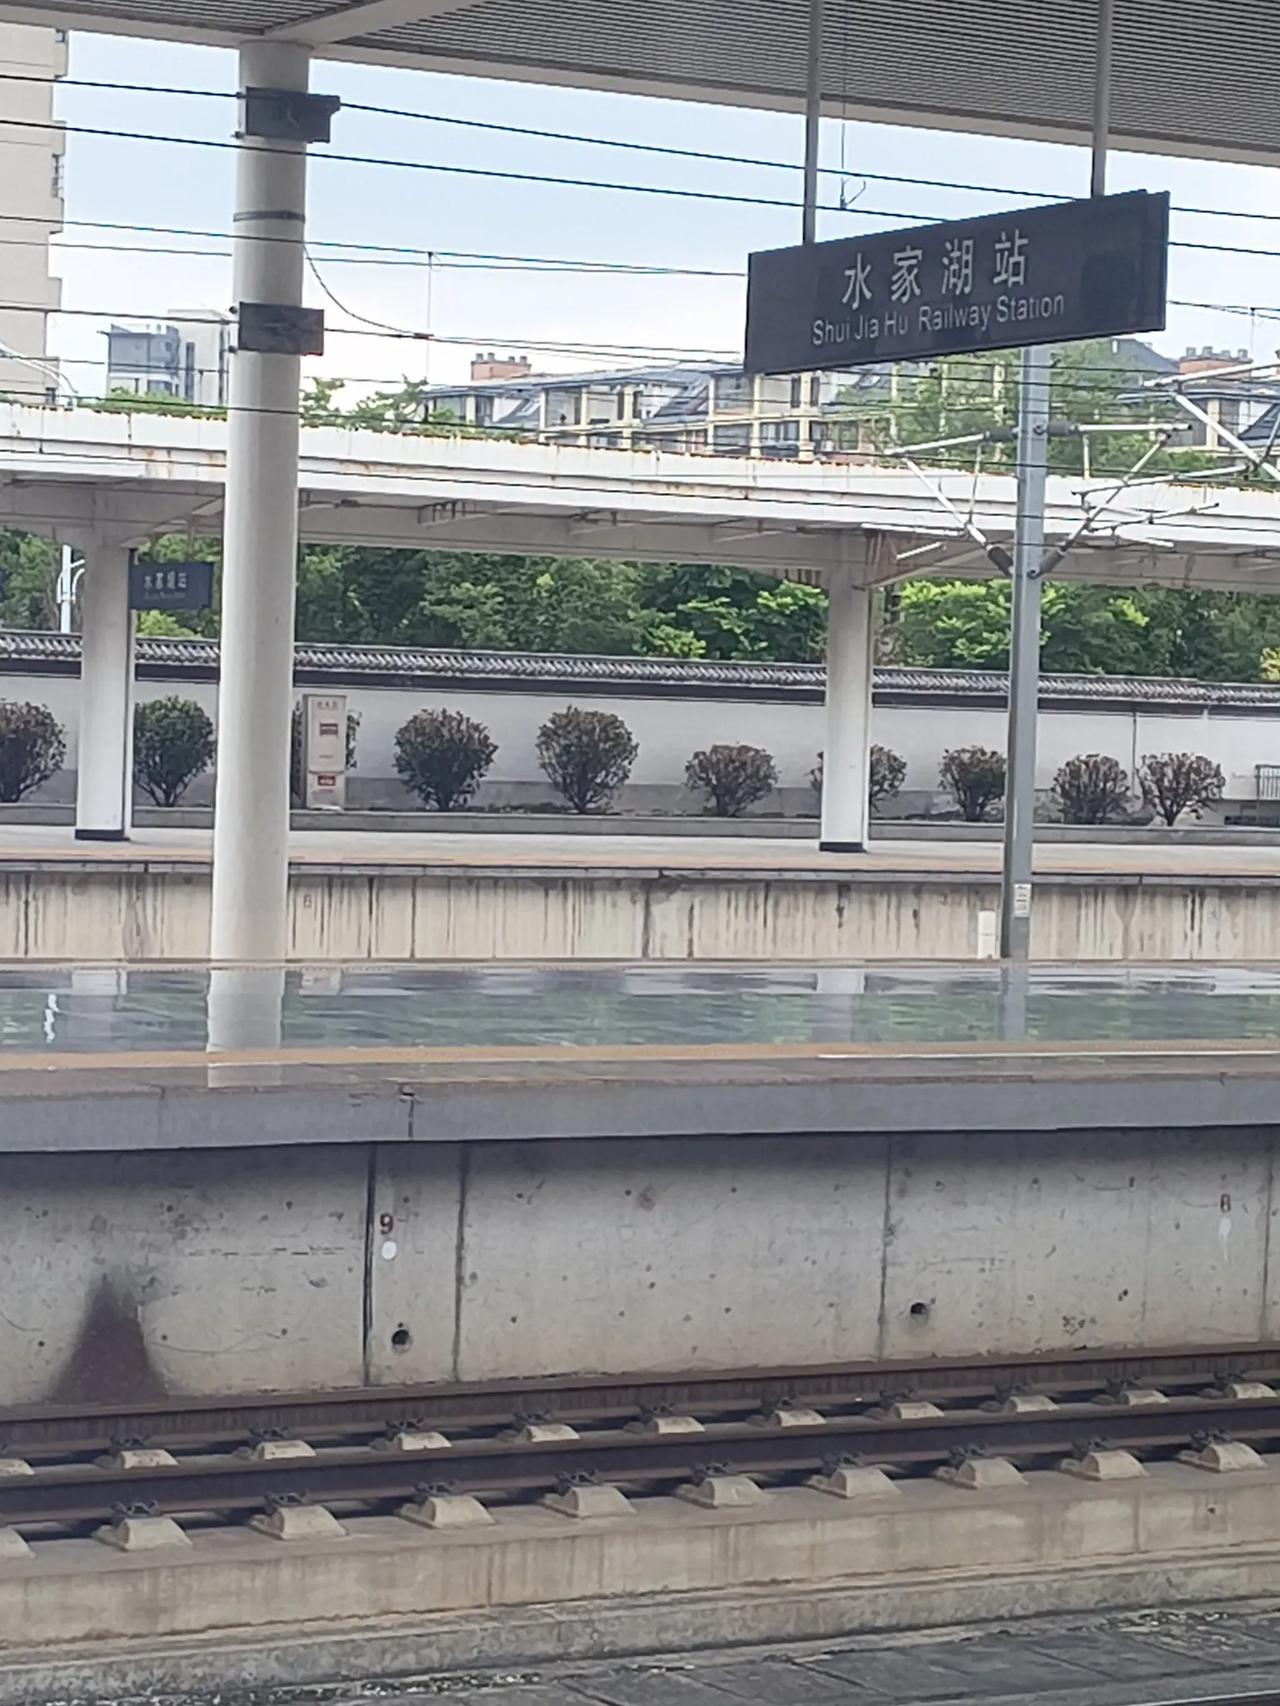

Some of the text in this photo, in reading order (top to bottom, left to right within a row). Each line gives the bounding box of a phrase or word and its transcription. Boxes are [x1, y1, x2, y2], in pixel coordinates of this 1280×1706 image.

[841, 228, 1029, 310] 水家湖站
[812, 294, 1064, 346] Shui Jia Hu Railway Station
[380, 1212, 394, 1235] 9
